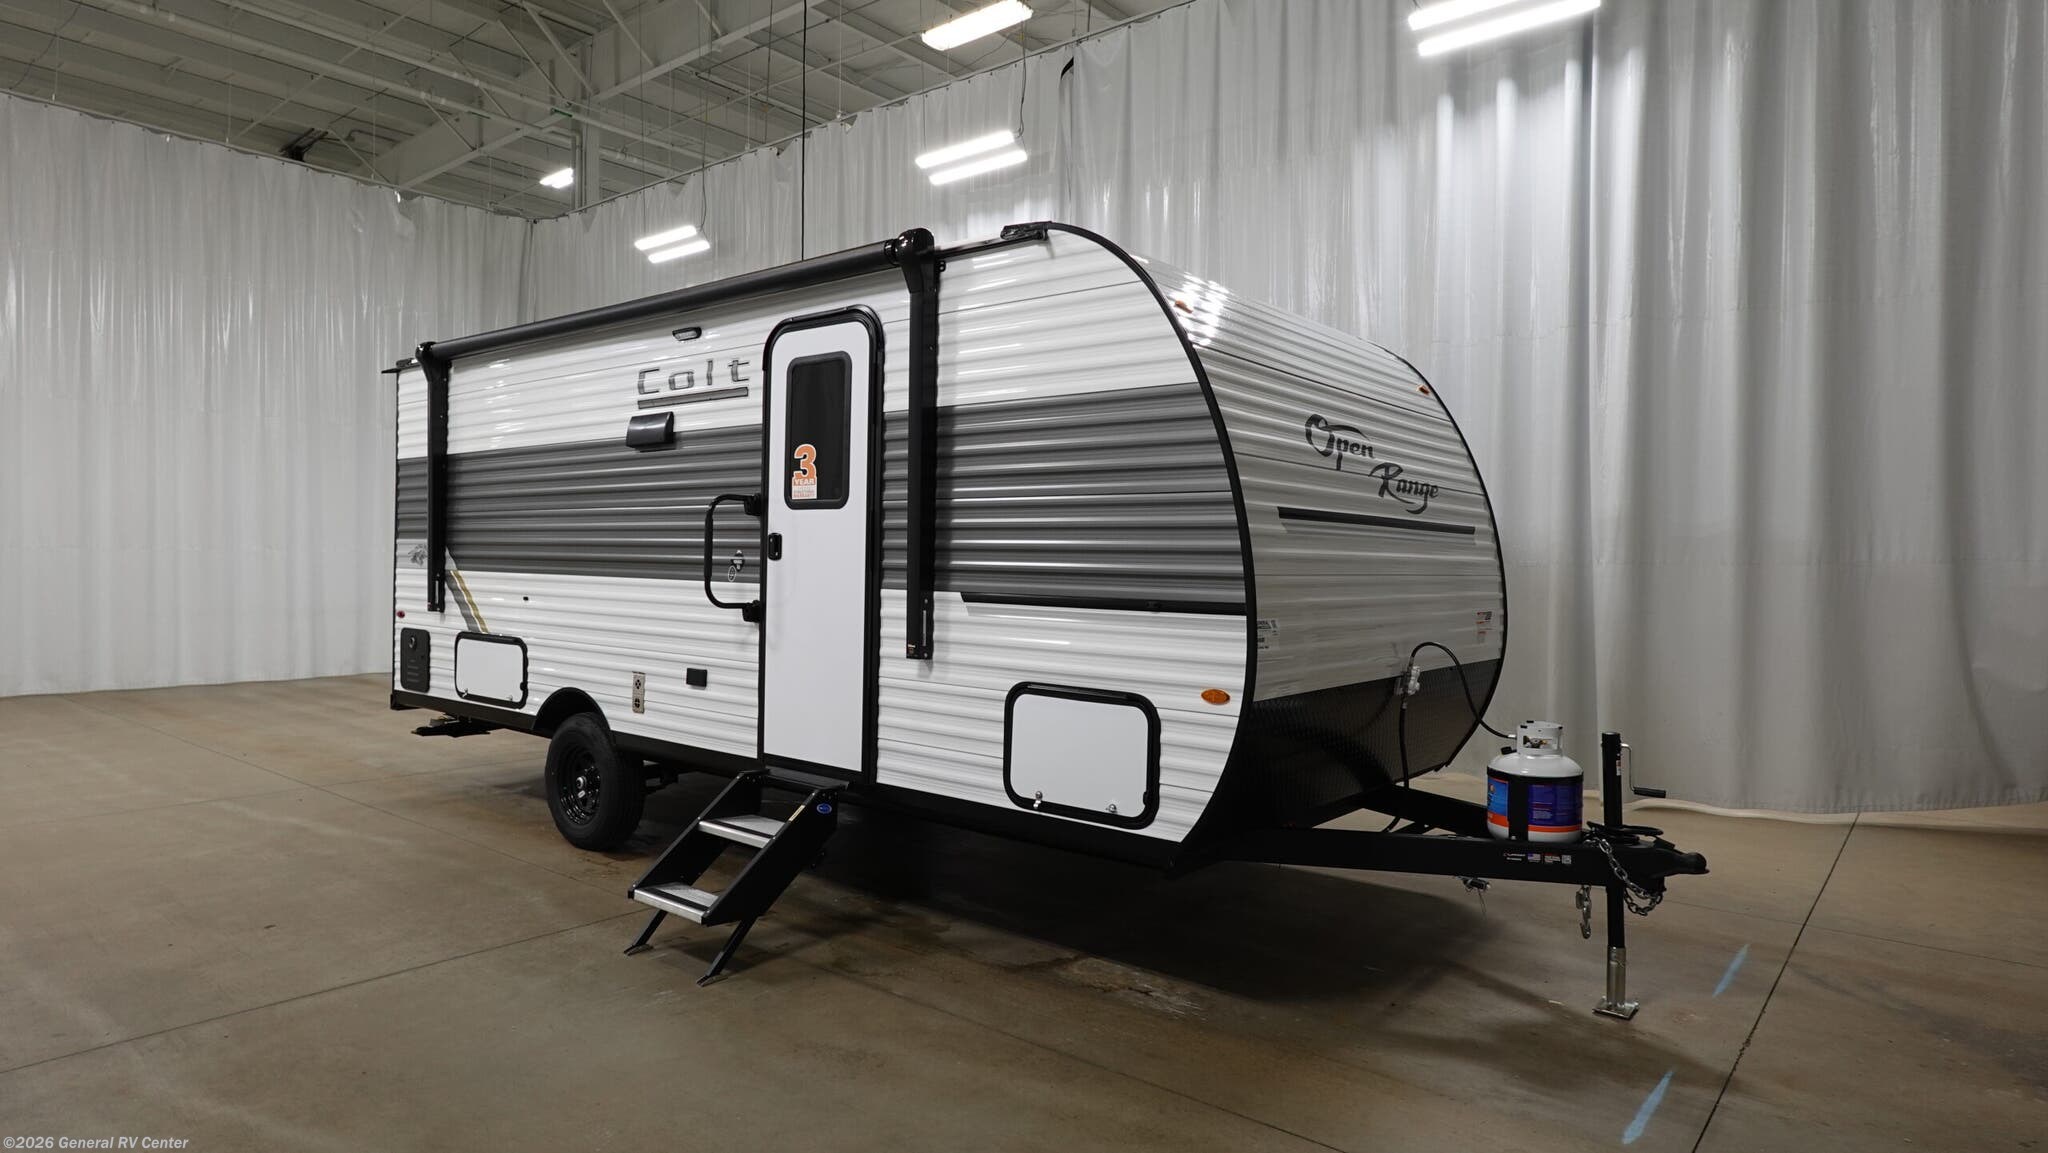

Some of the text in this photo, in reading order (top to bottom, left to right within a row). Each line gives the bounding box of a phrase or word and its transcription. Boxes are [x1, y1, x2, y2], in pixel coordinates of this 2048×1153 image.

[637, 359, 750, 395] Colt
[1305, 414, 1375, 471] Open
[794, 444, 817, 478] 3
[794, 478, 816, 486] YEAR
[1368, 462, 1439, 515] Range
